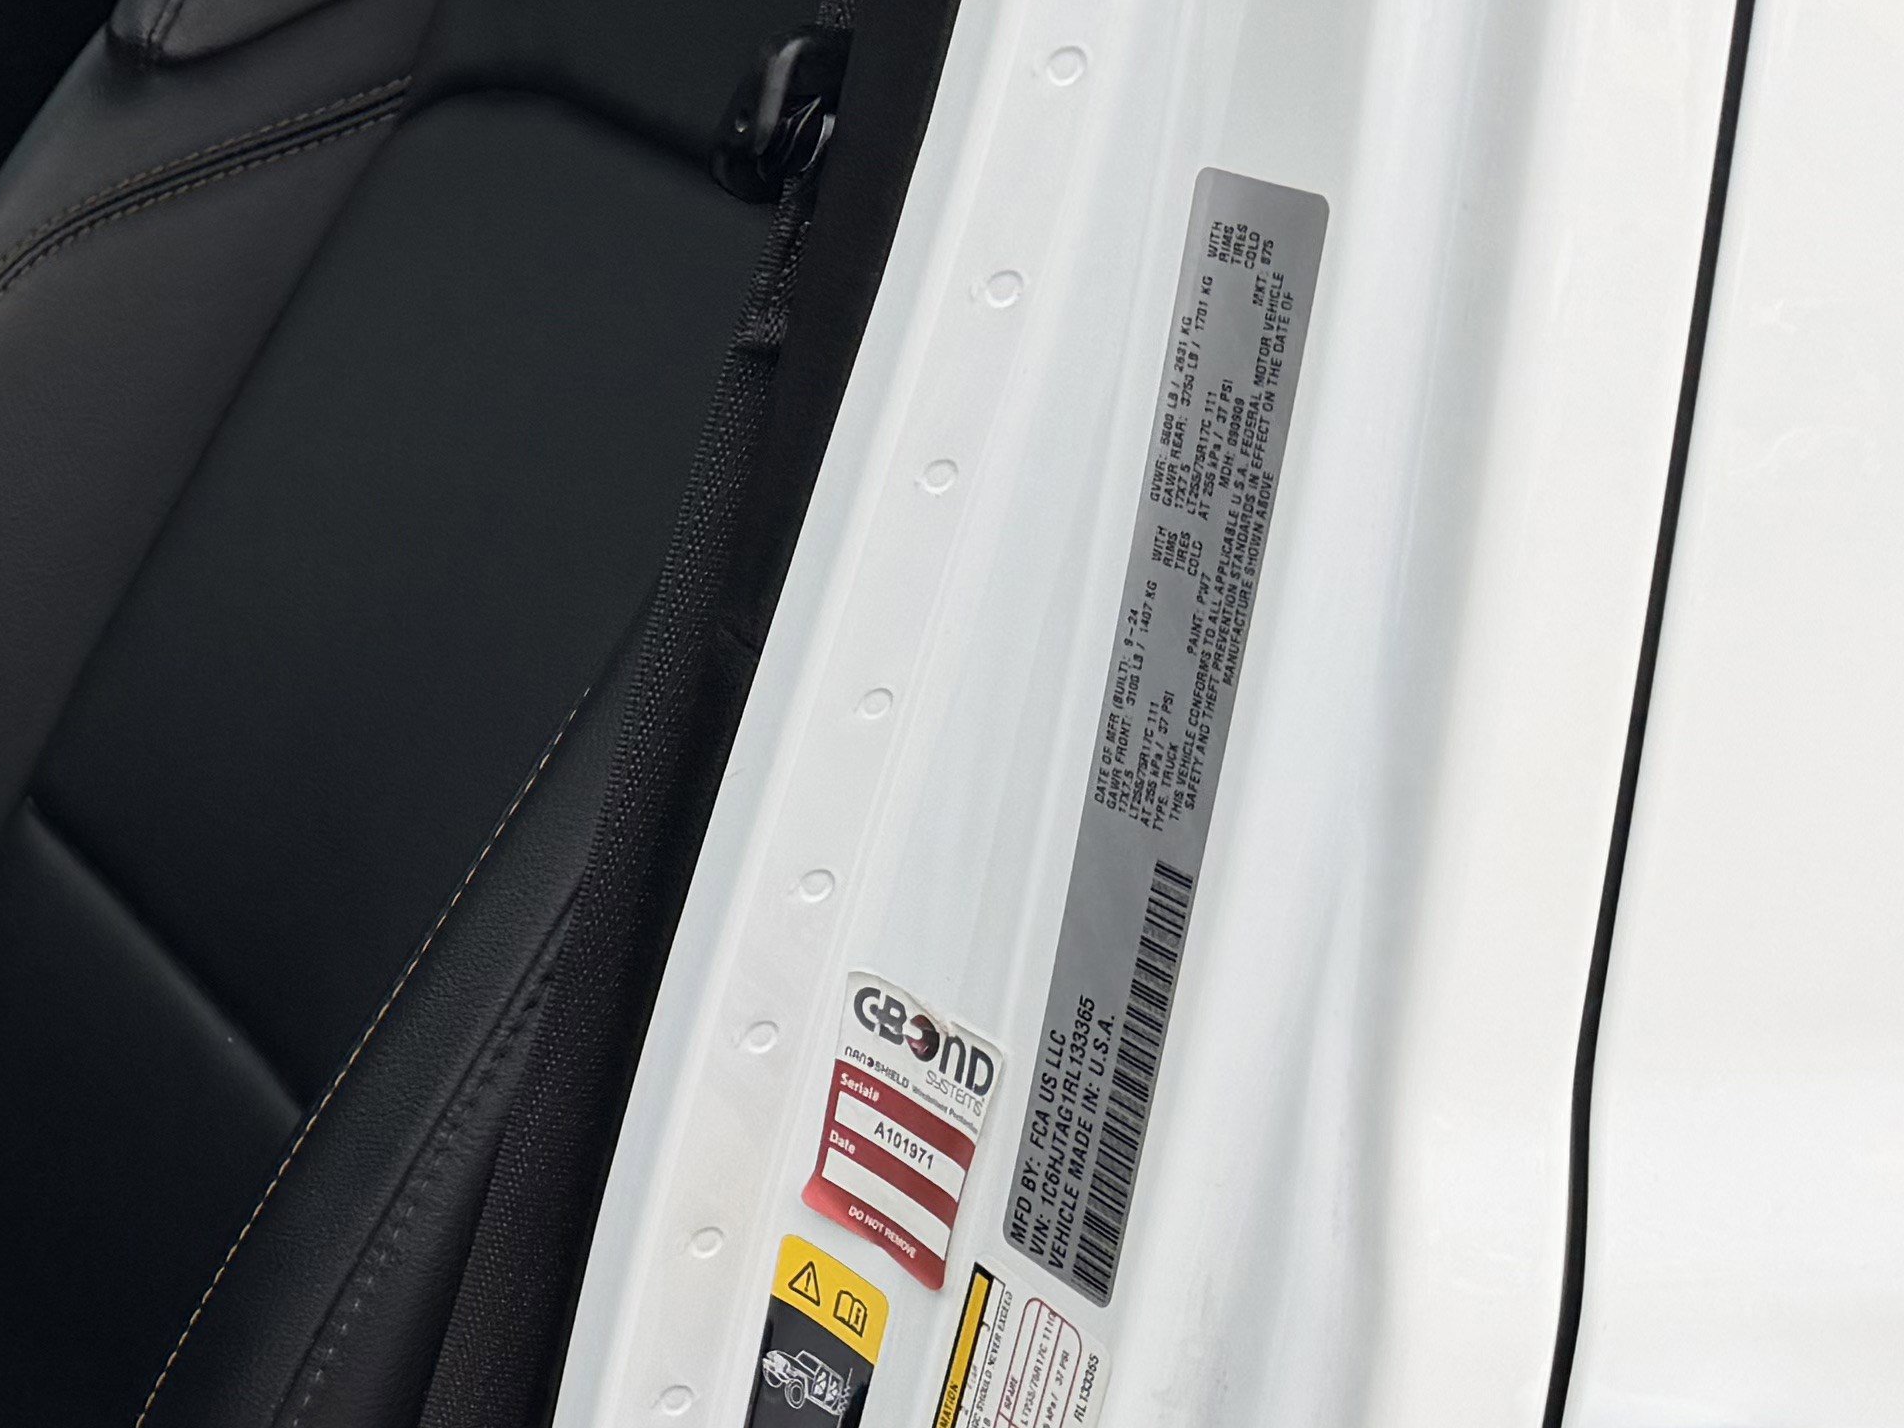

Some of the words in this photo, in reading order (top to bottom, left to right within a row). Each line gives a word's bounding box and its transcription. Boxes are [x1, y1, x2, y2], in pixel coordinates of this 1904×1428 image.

[1206, 220, 1223, 258] WITH
[1218, 224, 1235, 263] RIMS
[1230, 223, 1248, 265] TIRES
[1243, 231, 1261, 270] COLD
[1200, 274, 1213, 295] KG
[1262, 271, 1284, 331] VEHICLE
[1280, 290, 1294, 310] OF
[1193, 300, 1208, 331] 1701
[1272, 315, 1290, 353] DATE
[1166, 390, 1178, 409] LB
[1179, 315, 1192, 335] KG
[1186, 352, 1199, 369] LB
[1252, 335, 1272, 387] MOTOR
[1266, 357, 1282, 385] THE
[1203, 390, 1217, 414] 111
[1261, 389, 1275, 412] ON
[1239, 391, 1262, 457] FEDERAL
[1249, 415, 1271, 470] EFFECT
[1197, 502, 1210, 521] AT
[1219, 378, 1233, 402] PSI
[1217, 449, 1235, 489] MDH:
[1161, 462, 1179, 507] GAWR
[1246, 473, 1259, 489] IN
[1151, 524, 1167, 562] WITH
[1162, 530, 1178, 567] RIMS
[1174, 530, 1191, 572] TIRES
[1212, 508, 1240, 595] APPLICABLE
[1228, 492, 1256, 580] STANDARDS
[1186, 538, 1203, 577] COLD
[1221, 577, 1254, 686] MANUFACTURE
[1243, 521, 1264, 577] SHOWN
[1254, 469, 1274, 519] ABOVE
[1195, 571, 1211, 605] PW7
[1207, 596, 1222, 624] ALL
[1210, 582, 1238, 671] PREVENTION
[1202, 628, 1216, 647] TO
[1105, 766, 1122, 810] GAWR
[1131, 652, 1143, 670] LB
[1144, 579, 1157, 599] KG
[1161, 689, 1174, 714] PSI
[1187, 649, 1212, 727] CONFORMS
[1201, 674, 1220, 720] THEFT
[1146, 700, 1159, 724] 111
[1157, 715, 1169, 734] 37
[1101, 746, 1113, 765] OF
[1175, 729, 1196, 786] VEHICLE
[1195, 722, 1210, 754] AND
[1160, 740, 1179, 788] TRUCK
[1183, 755, 1204, 810] SAFETY
[1094, 767, 1110, 804] DATE
[1168, 788, 1184, 823] THIS
[1139, 808, 1151, 827] AT
[1044, 1027, 1066, 1069] LLC
[1087, 1007, 1115, 1078] U.S.A.
[1038, 1070, 1057, 1104] US
[1040, 993, 1095, 1212] 1C6HJTAG1RL133365
[1080, 1079, 1100, 1114] IN:
[829, 1128, 856, 1155] Date
[874, 1122, 935, 1170] A101971
[1029, 1105, 1051, 1151] FCA
[1067, 1115, 1093, 1182] MADE
[1020, 1153, 1041, 1194] BY:
[848, 1203, 863, 1223] DO
[864, 1213, 883, 1236] NOT
[883, 1226, 917, 1260] REMOVE
[1010, 1193, 1032, 1246] MFD
[1030, 1211, 1051, 1259] VIN:
[1049, 1181, 1080, 1273] VEHICLE
